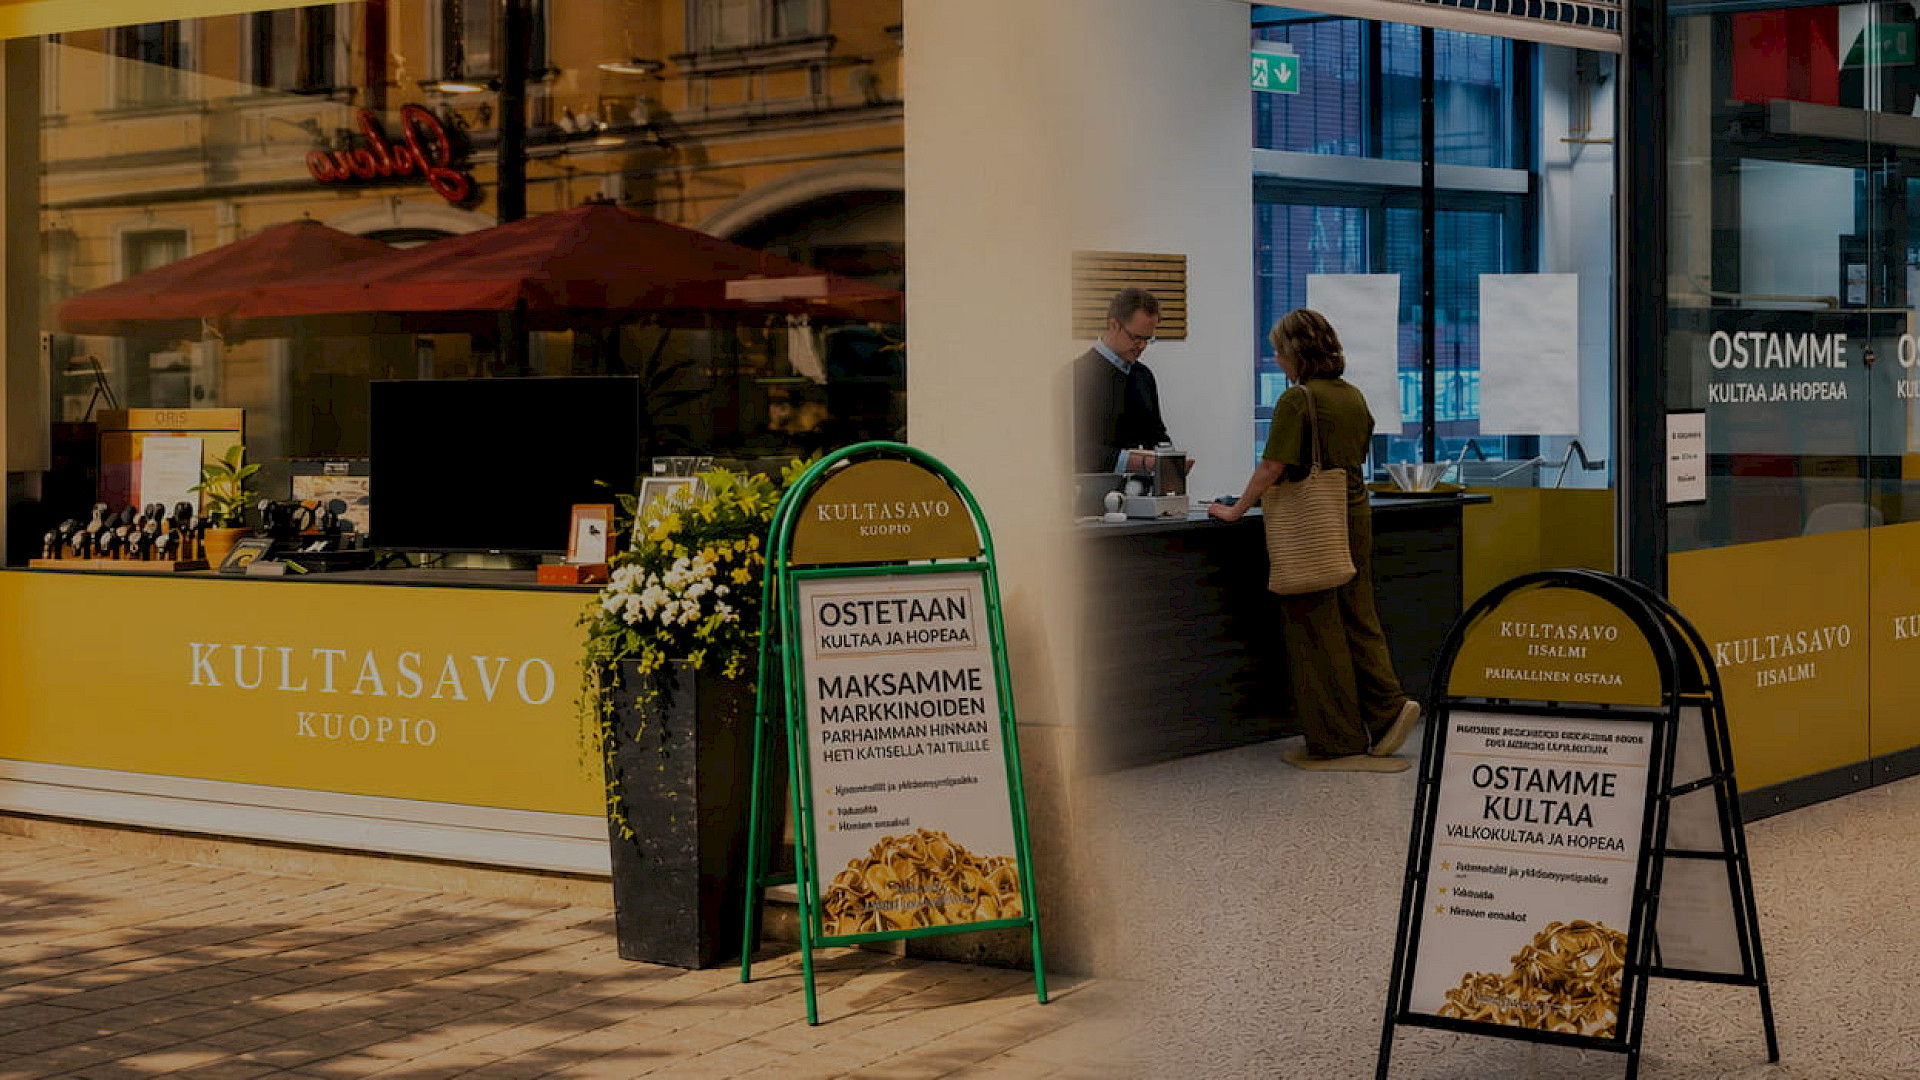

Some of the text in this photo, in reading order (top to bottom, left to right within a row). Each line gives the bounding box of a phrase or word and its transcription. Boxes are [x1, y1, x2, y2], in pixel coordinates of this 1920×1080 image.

[1709, 331, 1848, 369] OSTAMME
[1898, 333, 1920, 368] O
[1709, 381, 1848, 403] KULTAA JA HOPEAA
[817, 501, 950, 522] KULTASAVO
[860, 523, 911, 537] KUOPIO
[819, 596, 966, 627] OSTETAAN
[821, 628, 970, 649] KULTAA JA HOPEAA
[1501, 621, 1619, 642] KULTASAVO
[1528, 644, 1588, 659] IISALMI
[1715, 624, 1851, 668] KULTASAVO
[187, 641, 556, 705] KULTASAVO
[818, 668, 983, 700] MAKSAMME
[1485, 667, 1623, 685] PAIKALLINEN OSTAJA
[1756, 662, 1817, 688] IISALMI
[821, 697, 986, 724] MARKKINOIDEN
[296, 711, 437, 746] KUOPIO
[822, 720, 988, 745] PARHAIMMAN HINNAN
[824, 748, 854, 762] HETI
[927, 742, 946, 756] TAI
[1472, 764, 1617, 797] OSTAMME
[1483, 795, 1593, 828] KULTAA
[1446, 824, 1625, 851] VALKOKULTAA JA HOPEAA
